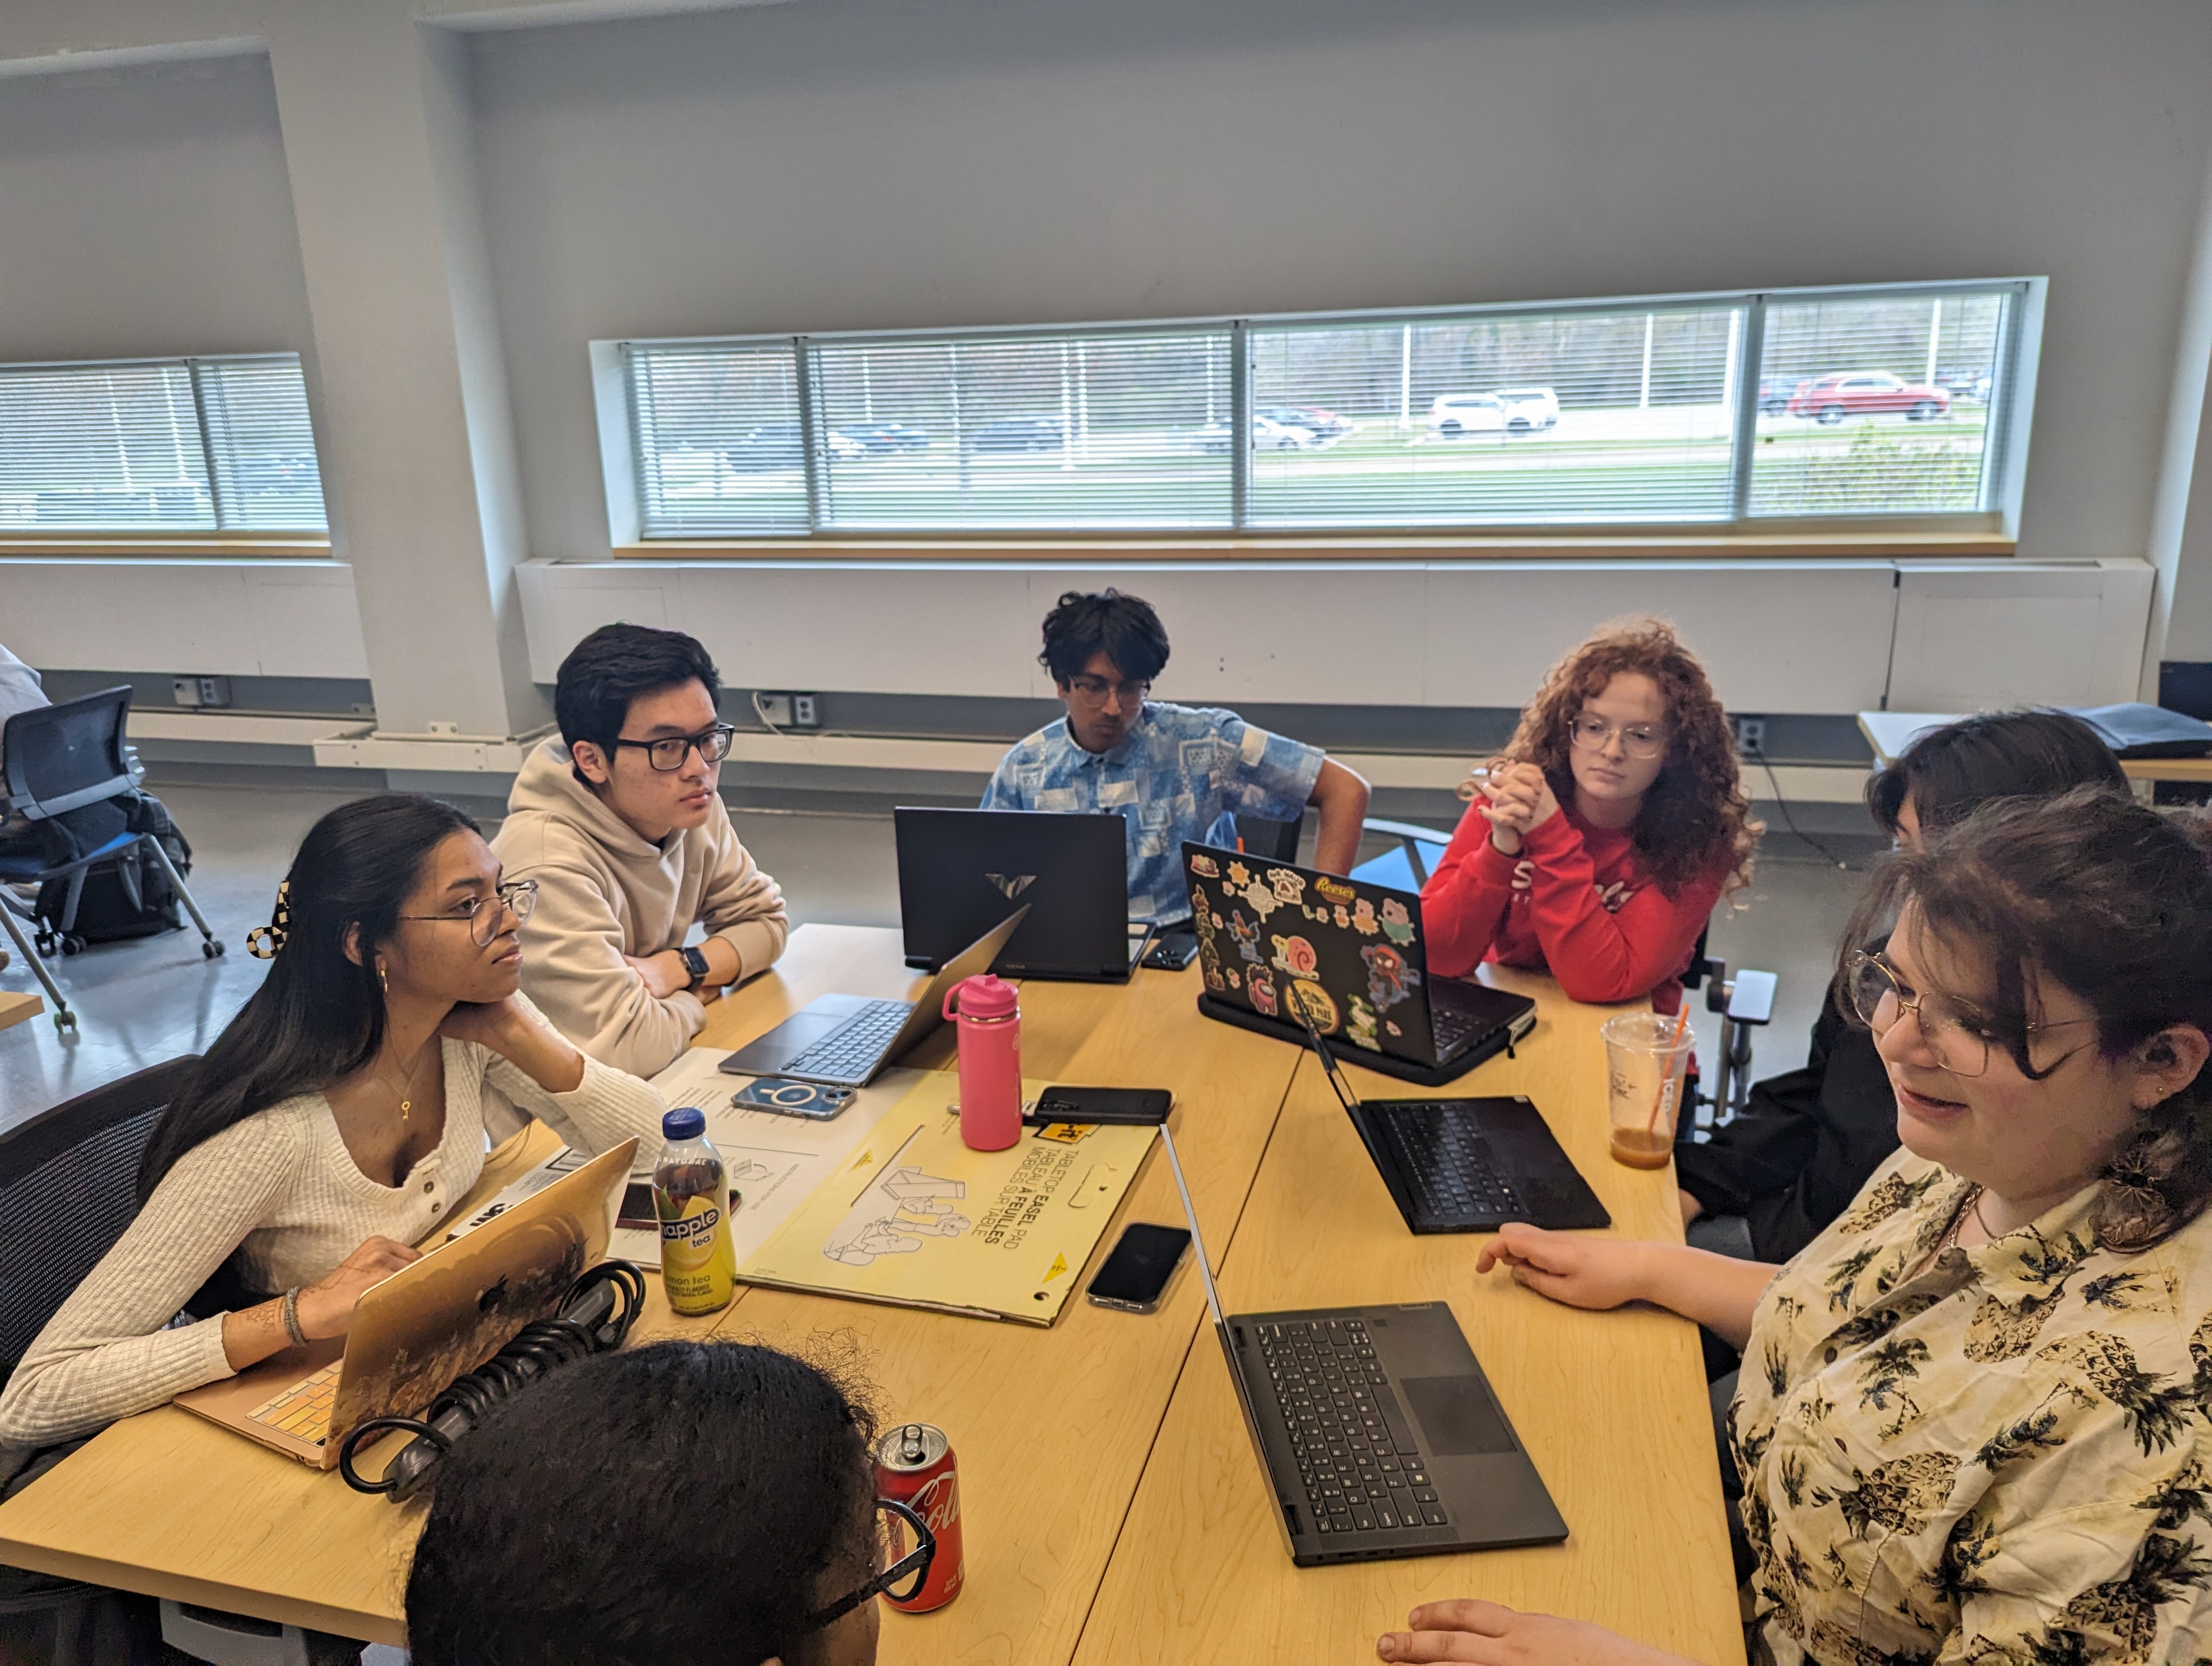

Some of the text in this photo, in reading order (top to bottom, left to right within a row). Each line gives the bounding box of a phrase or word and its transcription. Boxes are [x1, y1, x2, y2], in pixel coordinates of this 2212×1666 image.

[664, 1156, 706, 1165] NATURAL
[1025, 1148, 1061, 1185] TABLEAU
[1042, 1150, 1079, 1193] TABLETOP
[971, 1146, 1046, 1236] MOBILES SUR TABLE
[661, 1208, 717, 1240] napple
[985, 1196, 1028, 1244] FEUILLES
[1017, 1195, 1050, 1226] EASEL
[692, 1235, 711, 1247] tea
[1004, 1228, 1027, 1249] PAD
[693, 1275, 710, 1284] tea
